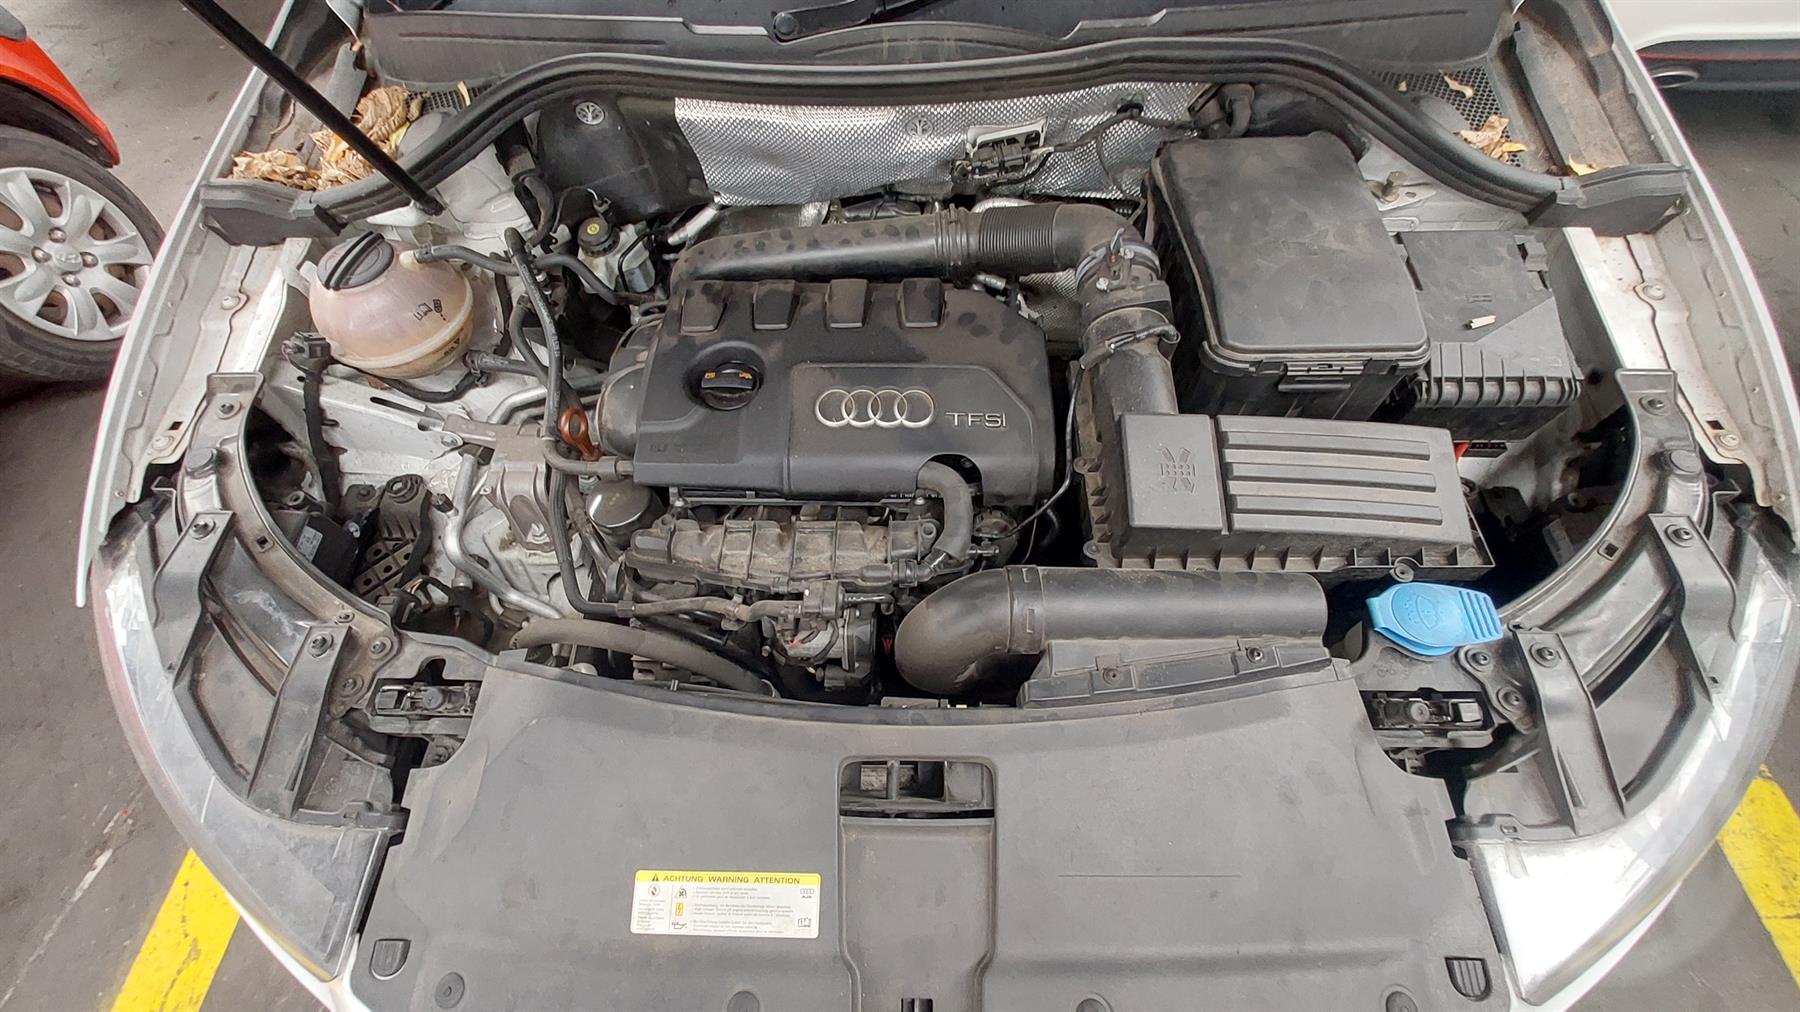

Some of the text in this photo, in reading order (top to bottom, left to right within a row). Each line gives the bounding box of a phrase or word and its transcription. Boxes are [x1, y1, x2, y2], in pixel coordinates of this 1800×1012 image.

[945, 412, 1006, 427] TFSI
[663, 875, 800, 885] ACHTUNG WARNING ATTENTION
